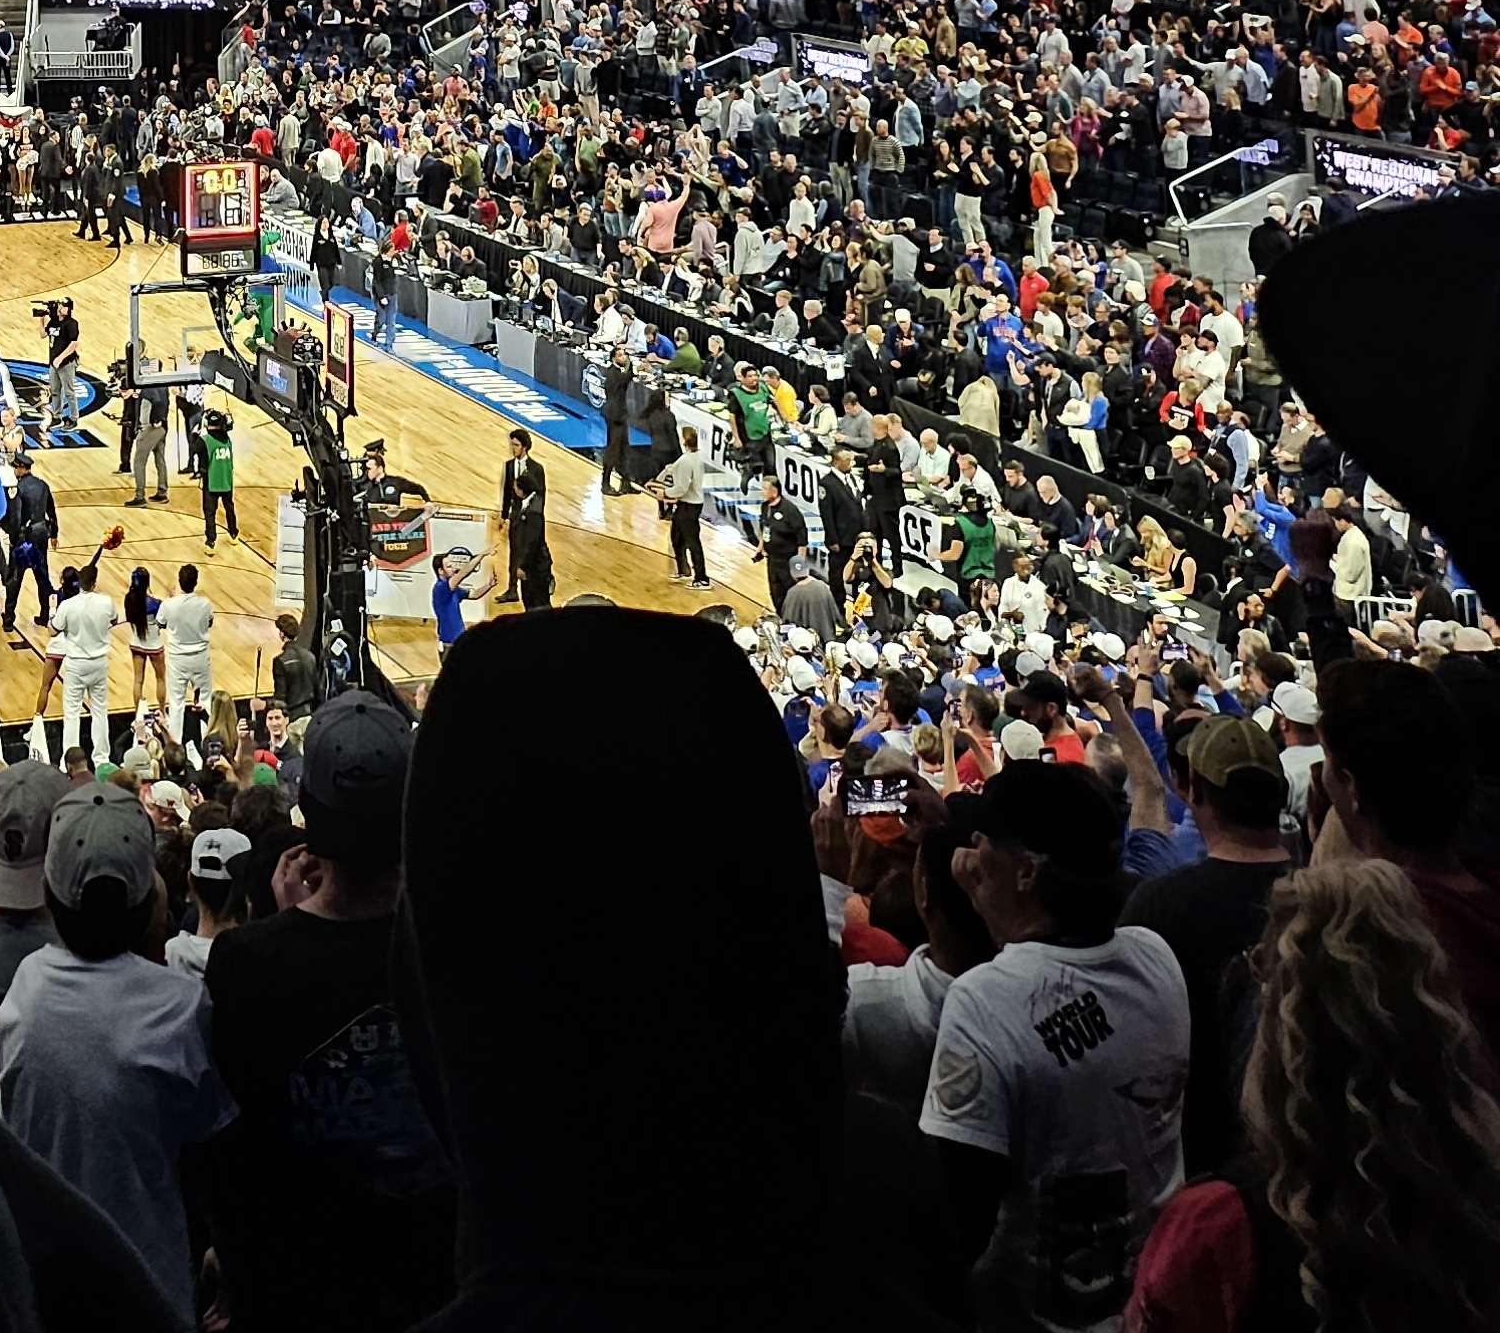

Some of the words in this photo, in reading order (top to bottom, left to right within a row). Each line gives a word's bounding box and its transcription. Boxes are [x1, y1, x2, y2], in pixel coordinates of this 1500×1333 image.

[1333, 150, 1371, 170] WEST
[1372, 155, 1441, 186] REGIONAL
[1033, 990, 1097, 1039] WORLD
[1043, 1003, 1115, 1068] TOUR
